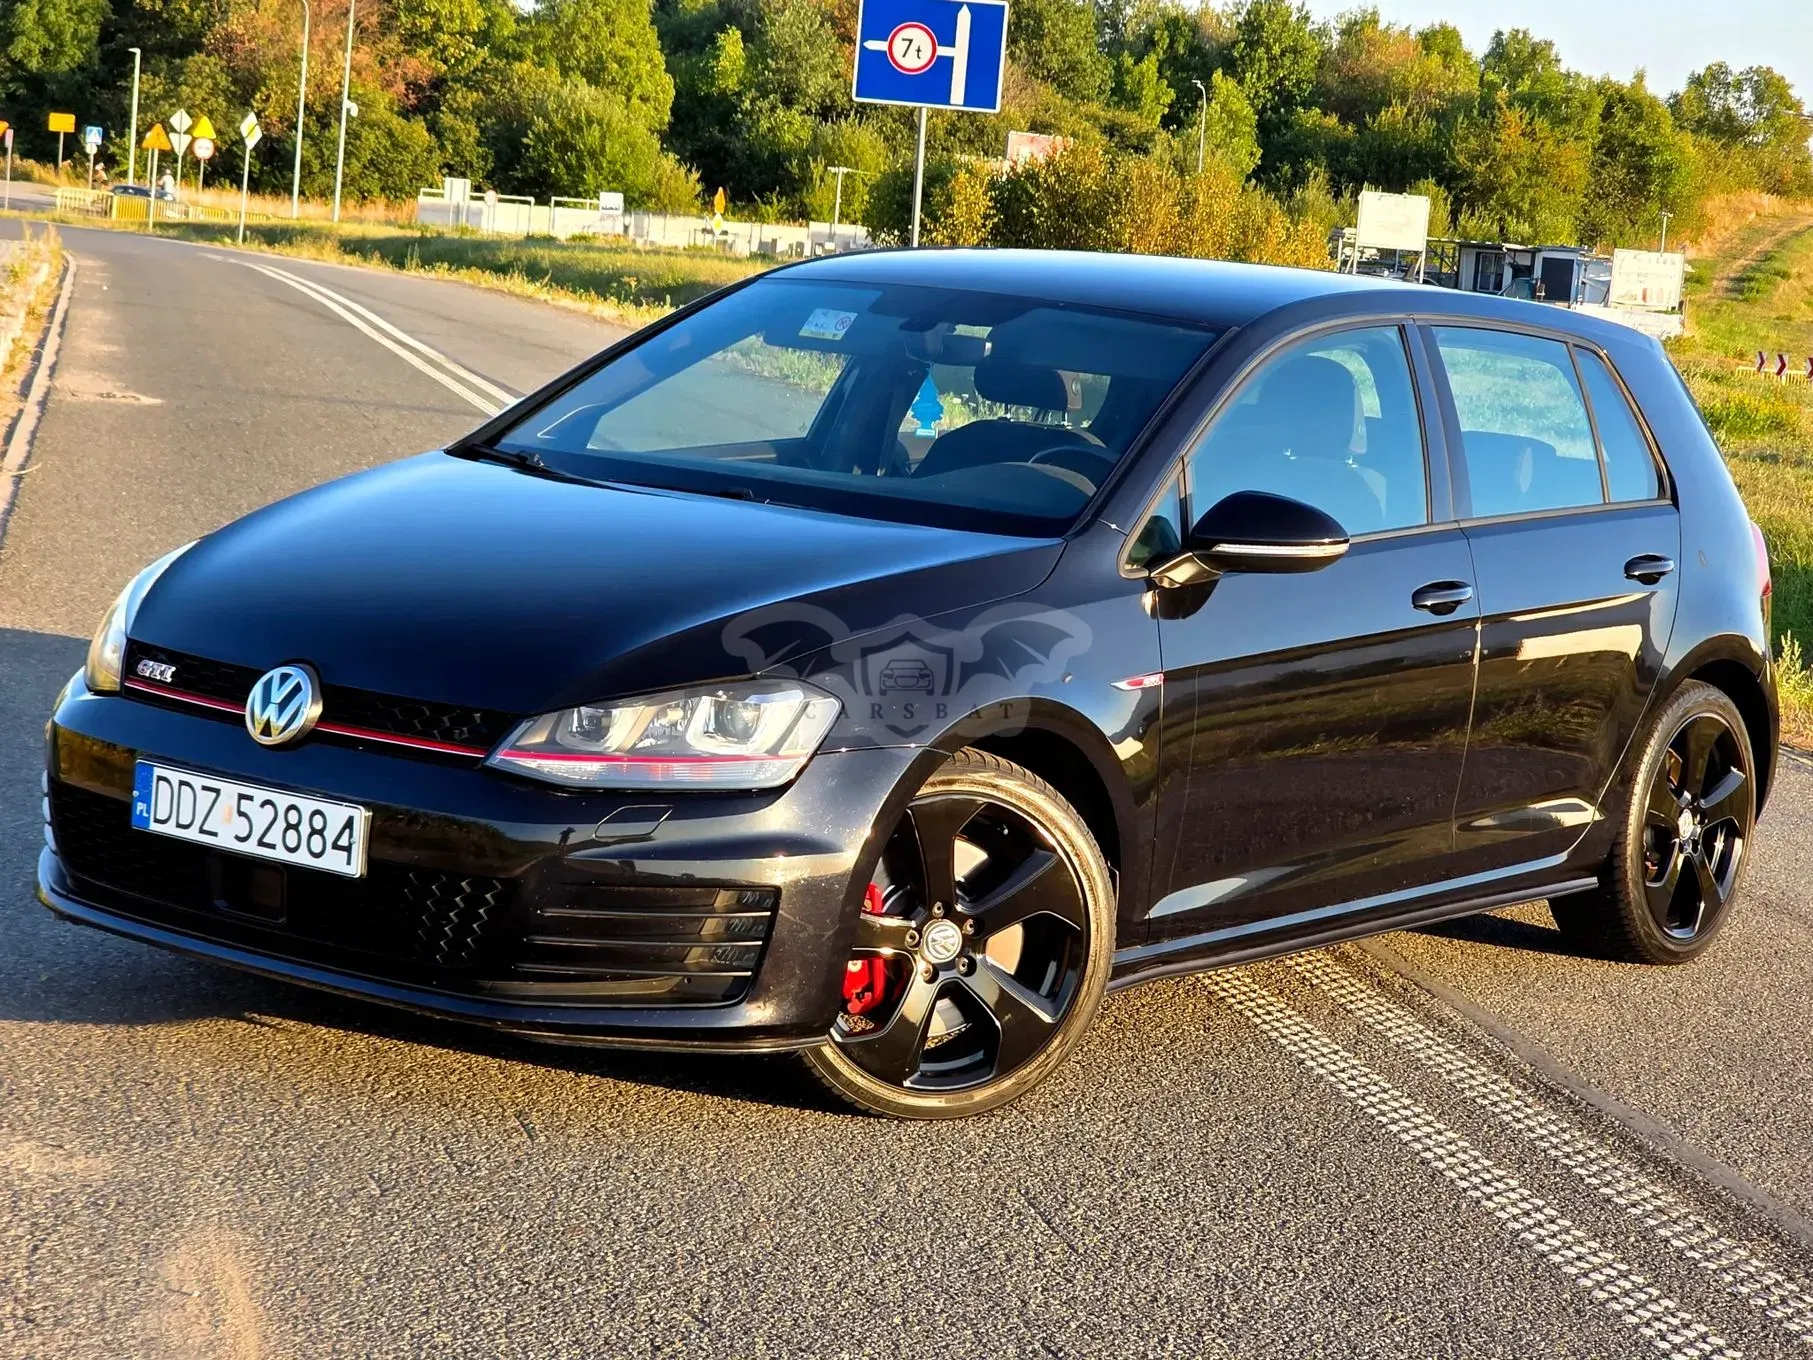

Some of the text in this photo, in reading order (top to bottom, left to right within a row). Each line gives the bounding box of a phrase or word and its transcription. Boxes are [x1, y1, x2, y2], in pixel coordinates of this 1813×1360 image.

[137, 660, 176, 682] GTI
[136, 803, 149, 818] PL
[153, 774, 355, 866] DDZ 52884
